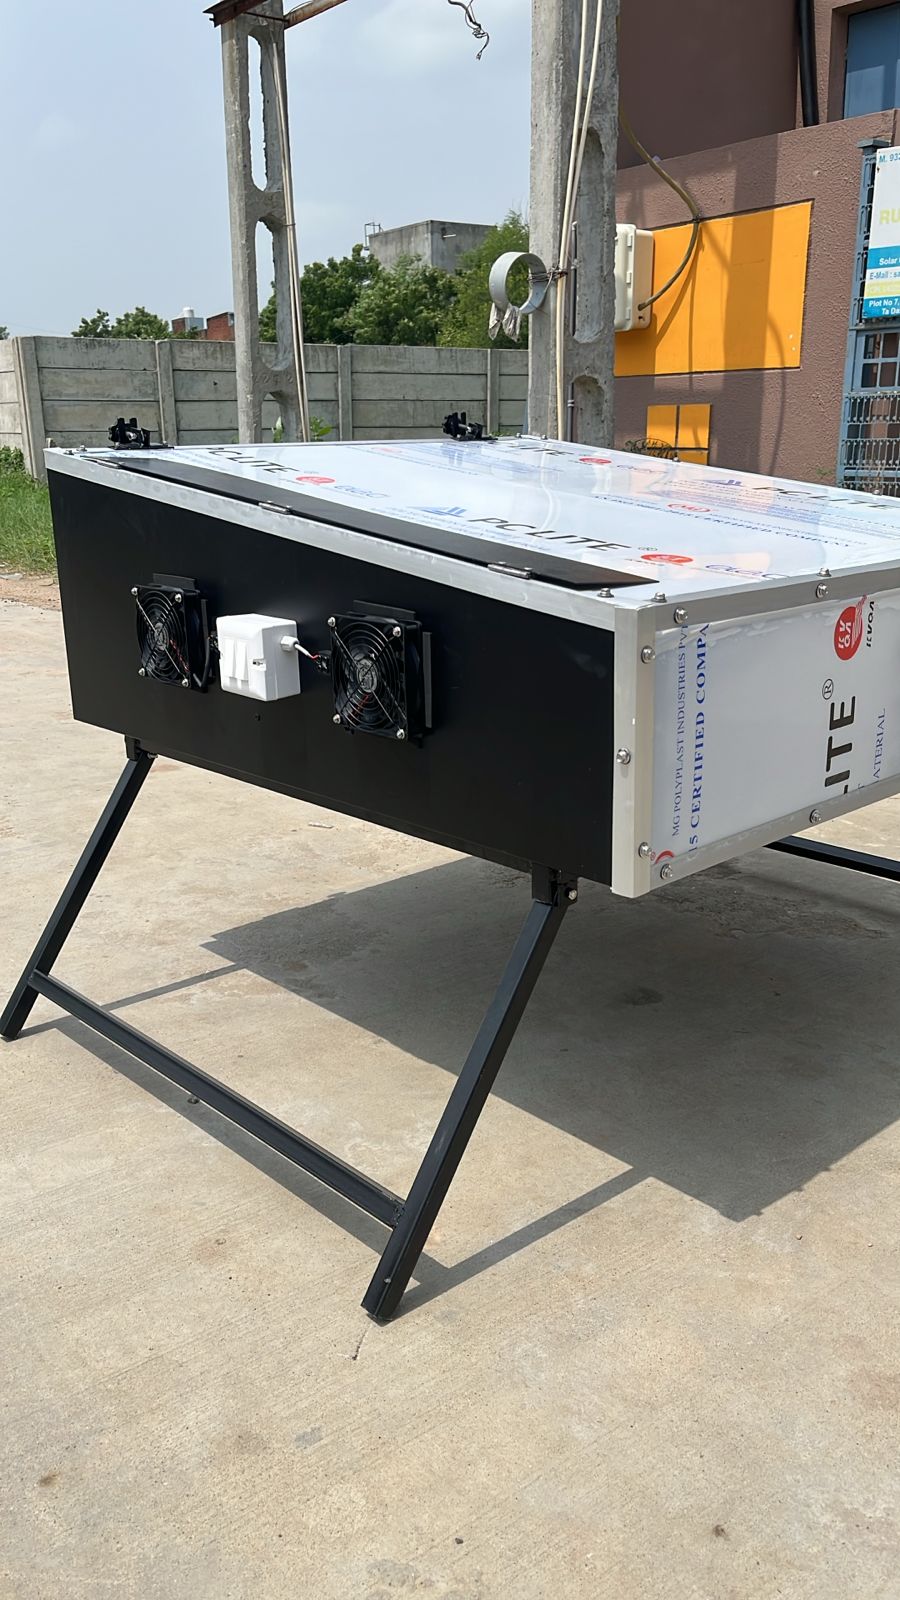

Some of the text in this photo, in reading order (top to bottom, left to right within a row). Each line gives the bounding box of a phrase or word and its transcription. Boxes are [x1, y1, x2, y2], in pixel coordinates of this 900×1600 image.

[870, 271, 888, 280] E-Mail
[879, 257, 897, 265] Solar
[883, 299, 893, 307] No
[677, 652, 686, 735] INDUSTRIES
[696, 623, 709, 704] COMPA
[674, 737, 685, 812] POLYPLAST
[691, 711, 705, 829] CERTIFIED
[824, 696, 856, 795] ITE
[872, 708, 885, 783] ATERIAL
[672, 815, 681, 837] MG
